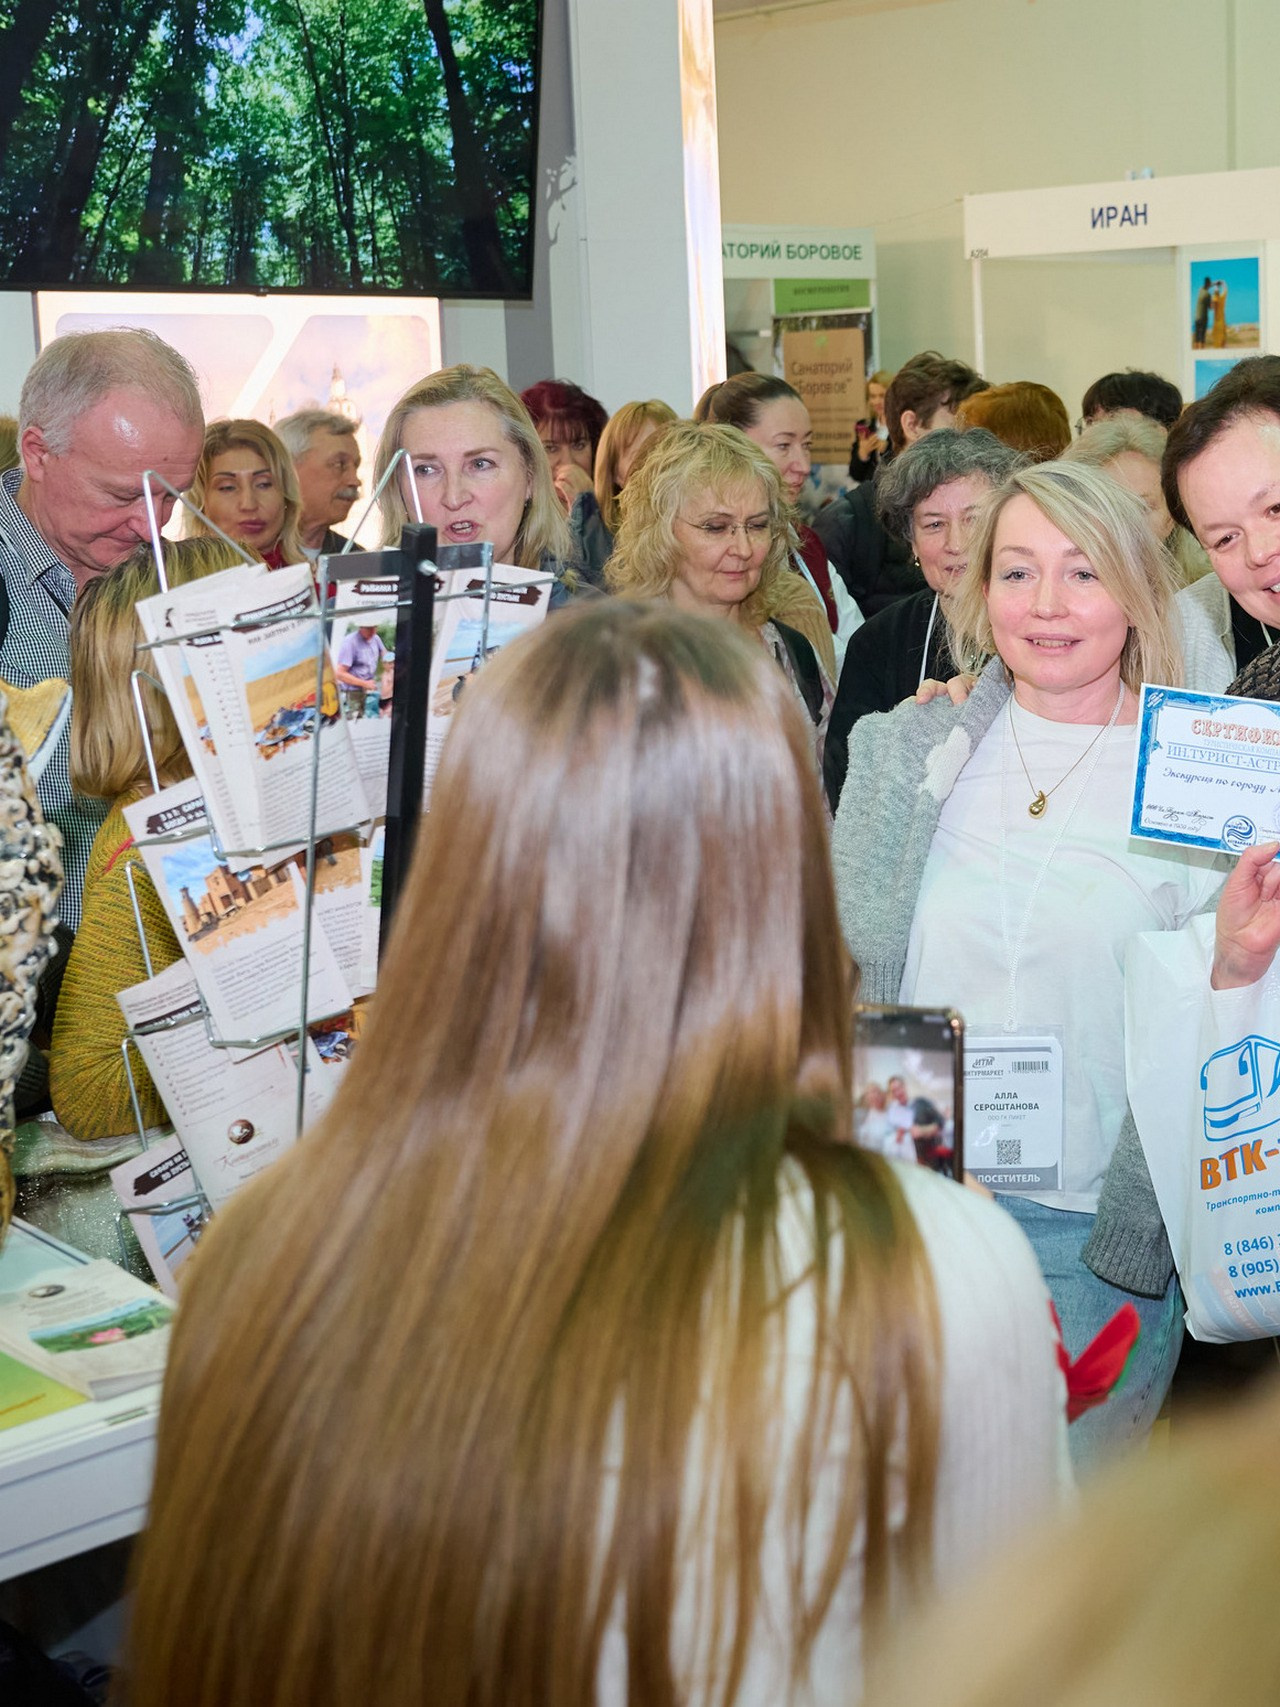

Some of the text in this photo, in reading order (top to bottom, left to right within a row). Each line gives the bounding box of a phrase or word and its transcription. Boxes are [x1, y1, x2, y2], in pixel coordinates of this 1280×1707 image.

[1091, 204, 1148, 229] ИРАН
[787, 244, 863, 260] БОРОВОЕ
[791, 359, 853, 377] Санаторий
[1163, 767, 1213, 786] Экскурсия
[1216, 779, 1229, 787] по
[1231, 779, 1266, 794] городу
[994, 1092, 1018, 1100] АЛЛА
[974, 1103, 1039, 1111] СЕРОШТАНОВА
[978, 1173, 1040, 1184] ПОСЕТИТЕЛЬ
[1224, 1241, 1233, 1255] 8
[1236, 1234, 1274, 1256] (846)
[1229, 1265, 1238, 1278] 8
[1241, 1257, 1280, 1279] (905)
